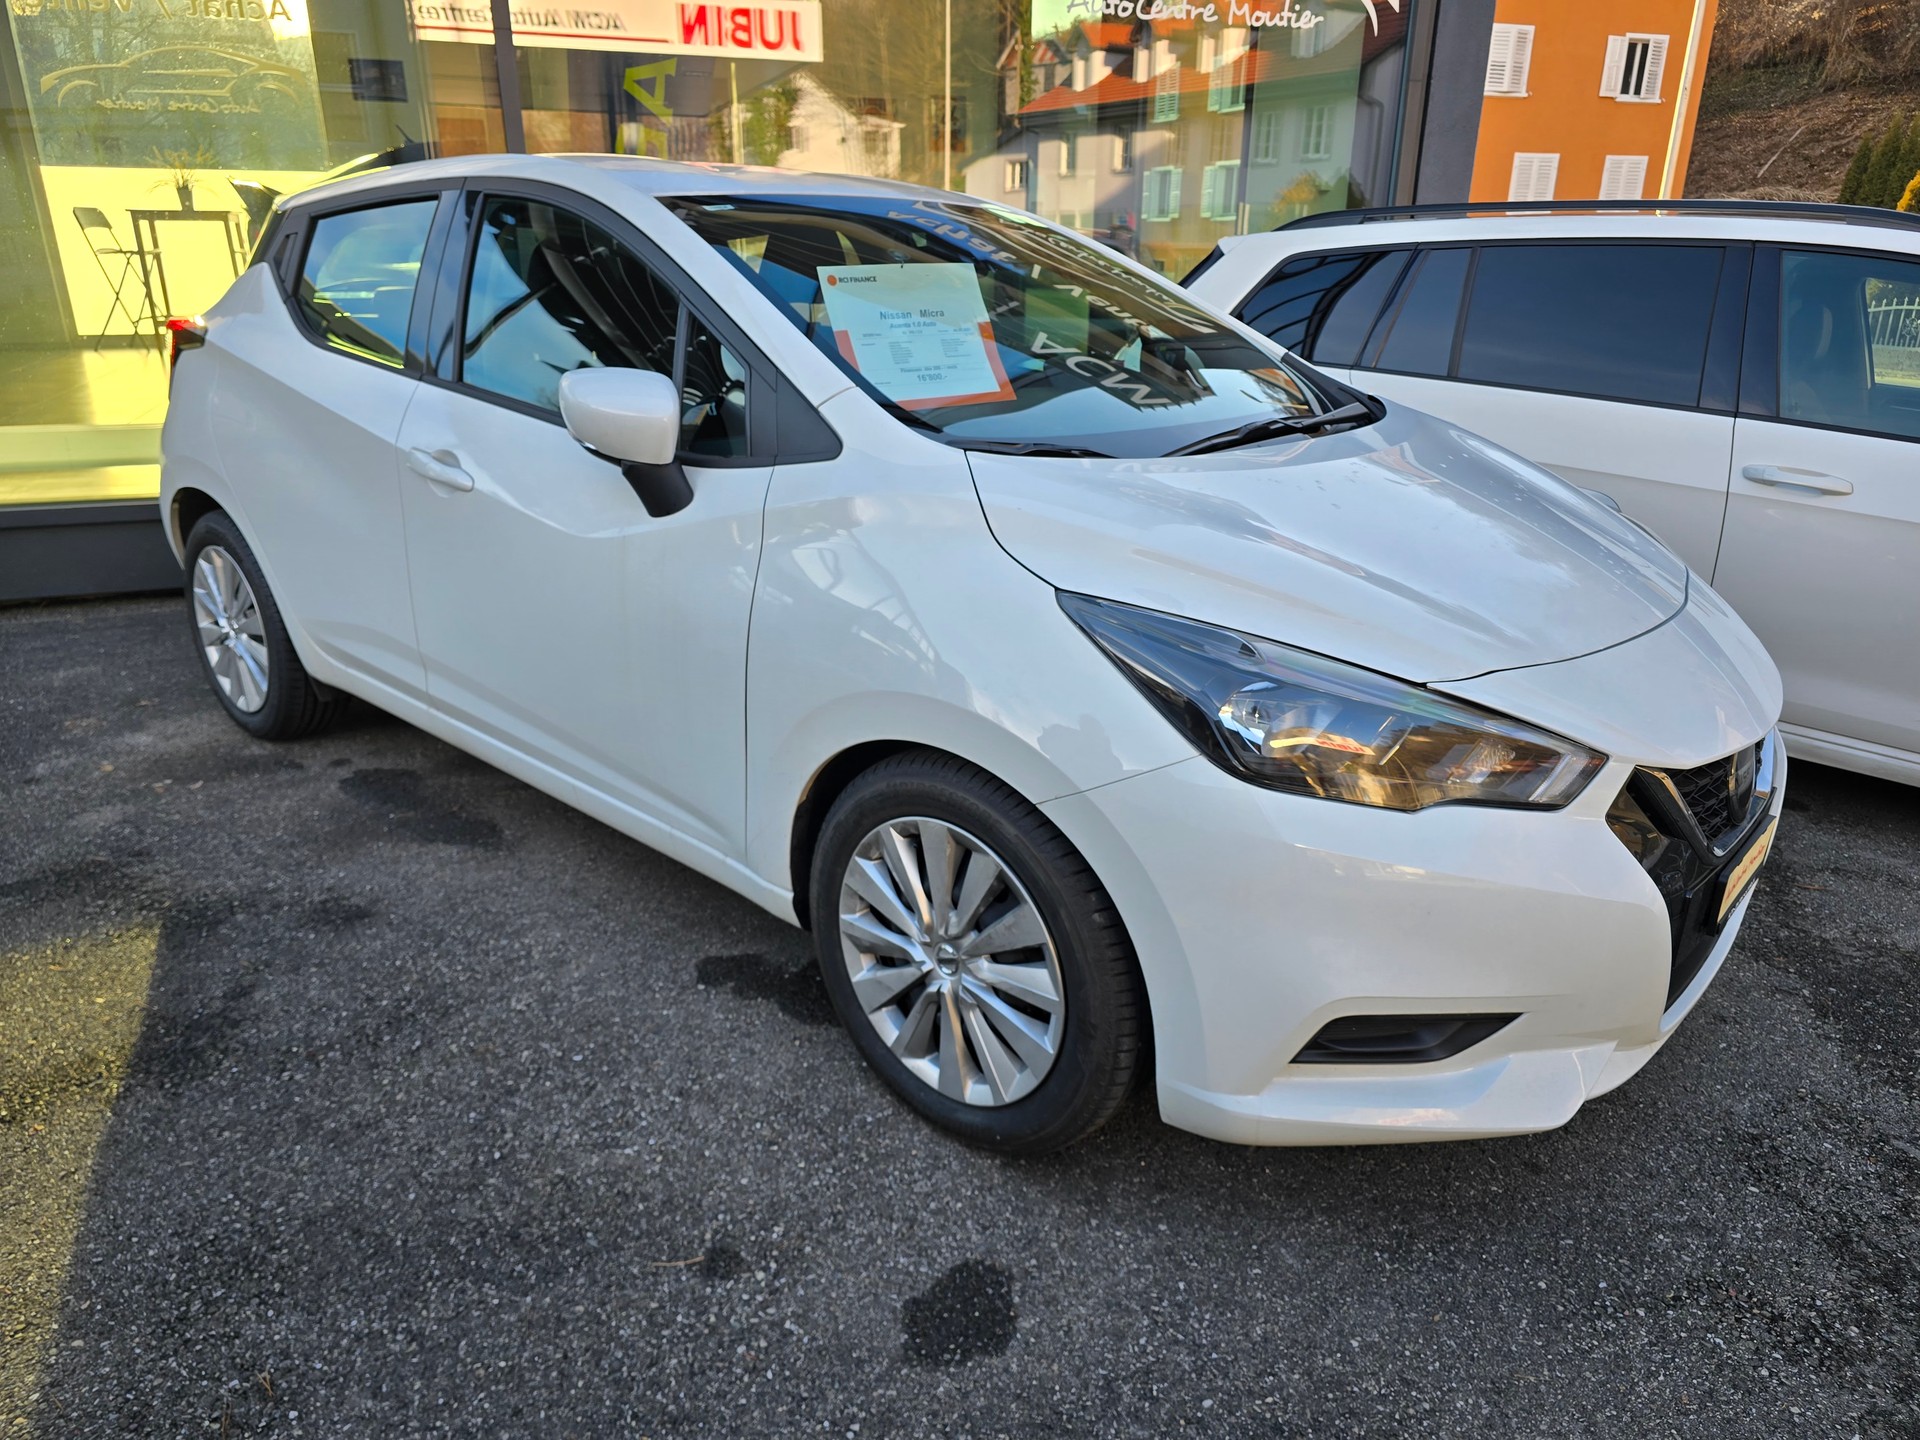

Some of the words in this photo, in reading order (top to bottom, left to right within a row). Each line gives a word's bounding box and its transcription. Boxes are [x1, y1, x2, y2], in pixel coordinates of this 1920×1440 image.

[1228, 5, 1325, 29] Moutier
[850, 275, 878, 283] FINANCE
[880, 311, 913, 321] Nissan
[920, 309, 945, 318] Micra
